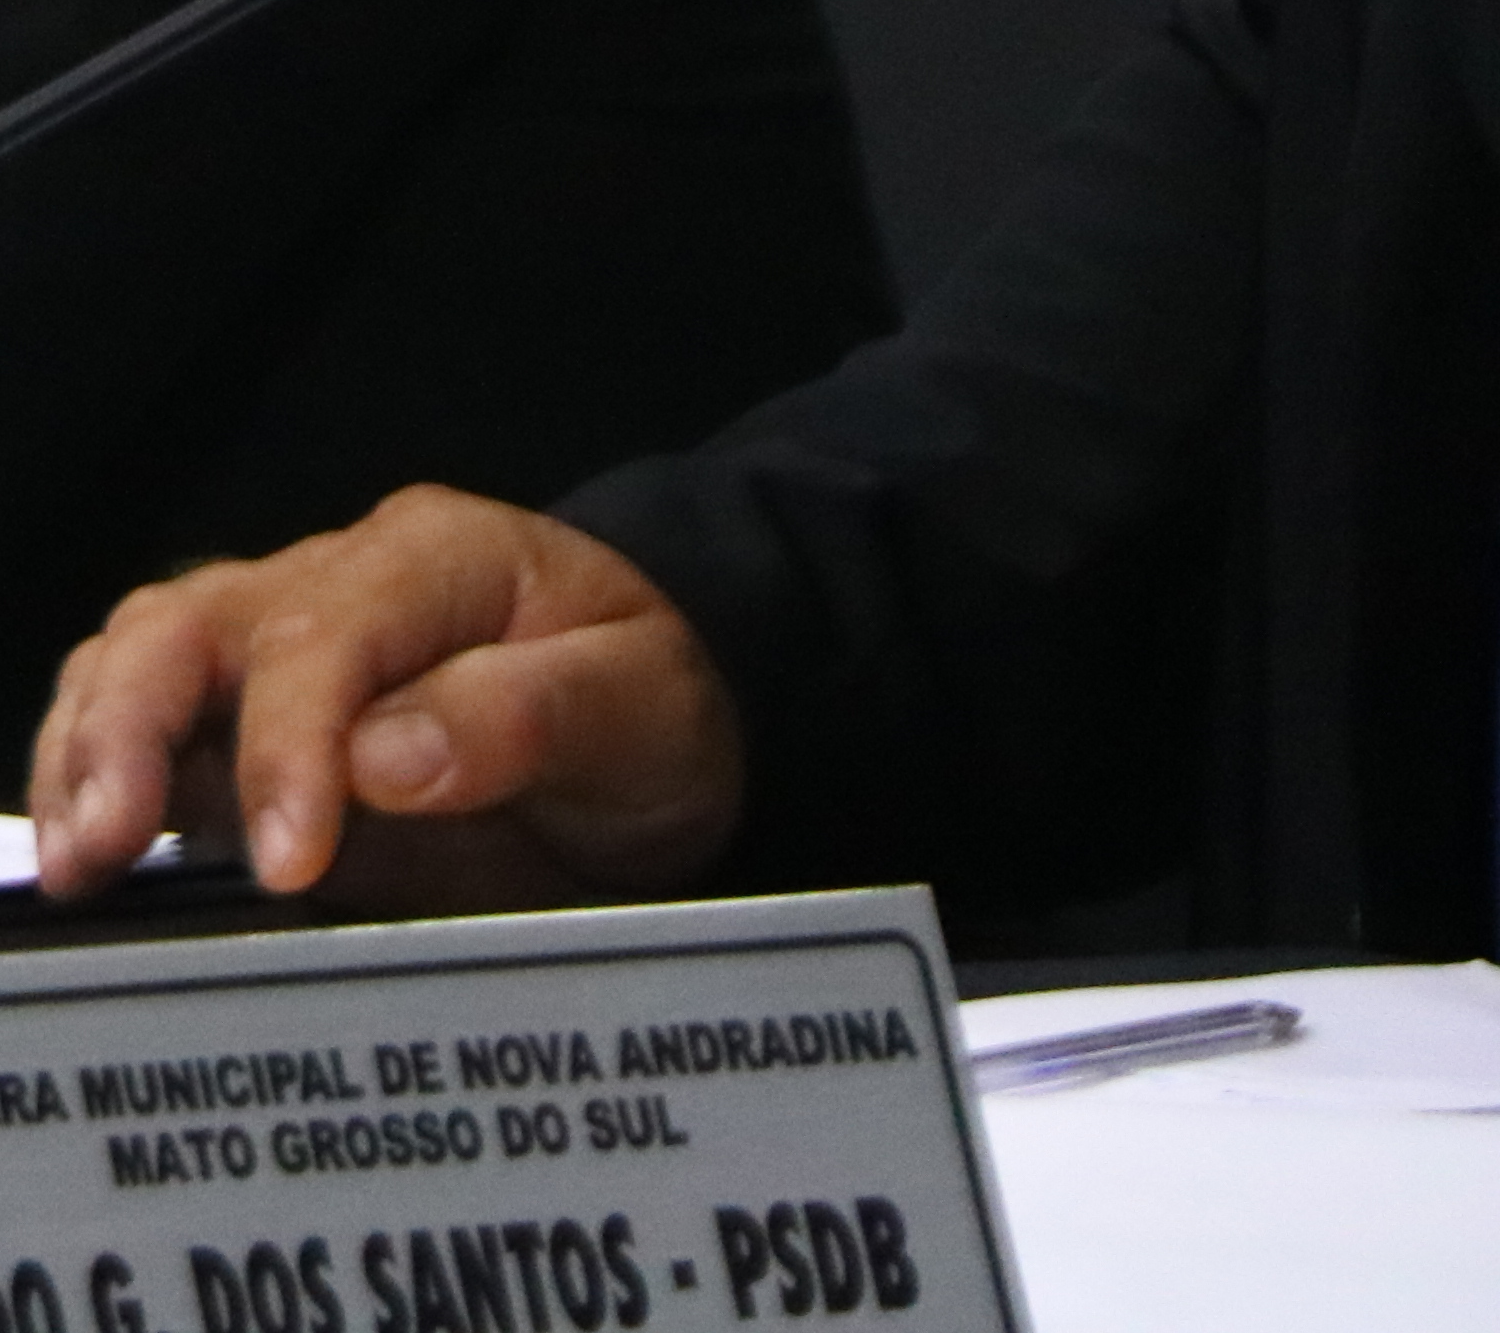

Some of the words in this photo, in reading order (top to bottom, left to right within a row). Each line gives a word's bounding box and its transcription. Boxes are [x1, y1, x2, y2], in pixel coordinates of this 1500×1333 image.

[78, 1048, 365, 1119] MUNICIPAL
[373, 1041, 445, 1097] DE
[457, 1029, 603, 1090] NOVA
[617, 1007, 918, 1080] ANDRADINA
[106, 1123, 260, 1187] MATO
[270, 1105, 483, 1175] GROSSO
[495, 1102, 571, 1158] DO
[583, 1094, 688, 1152] SUL
[90, 1251, 171, 1333] G
[191, 1235, 348, 1333] DOS
[360, 1211, 650, 1333] SANTOS
[713, 1193, 920, 1321] PSDB
